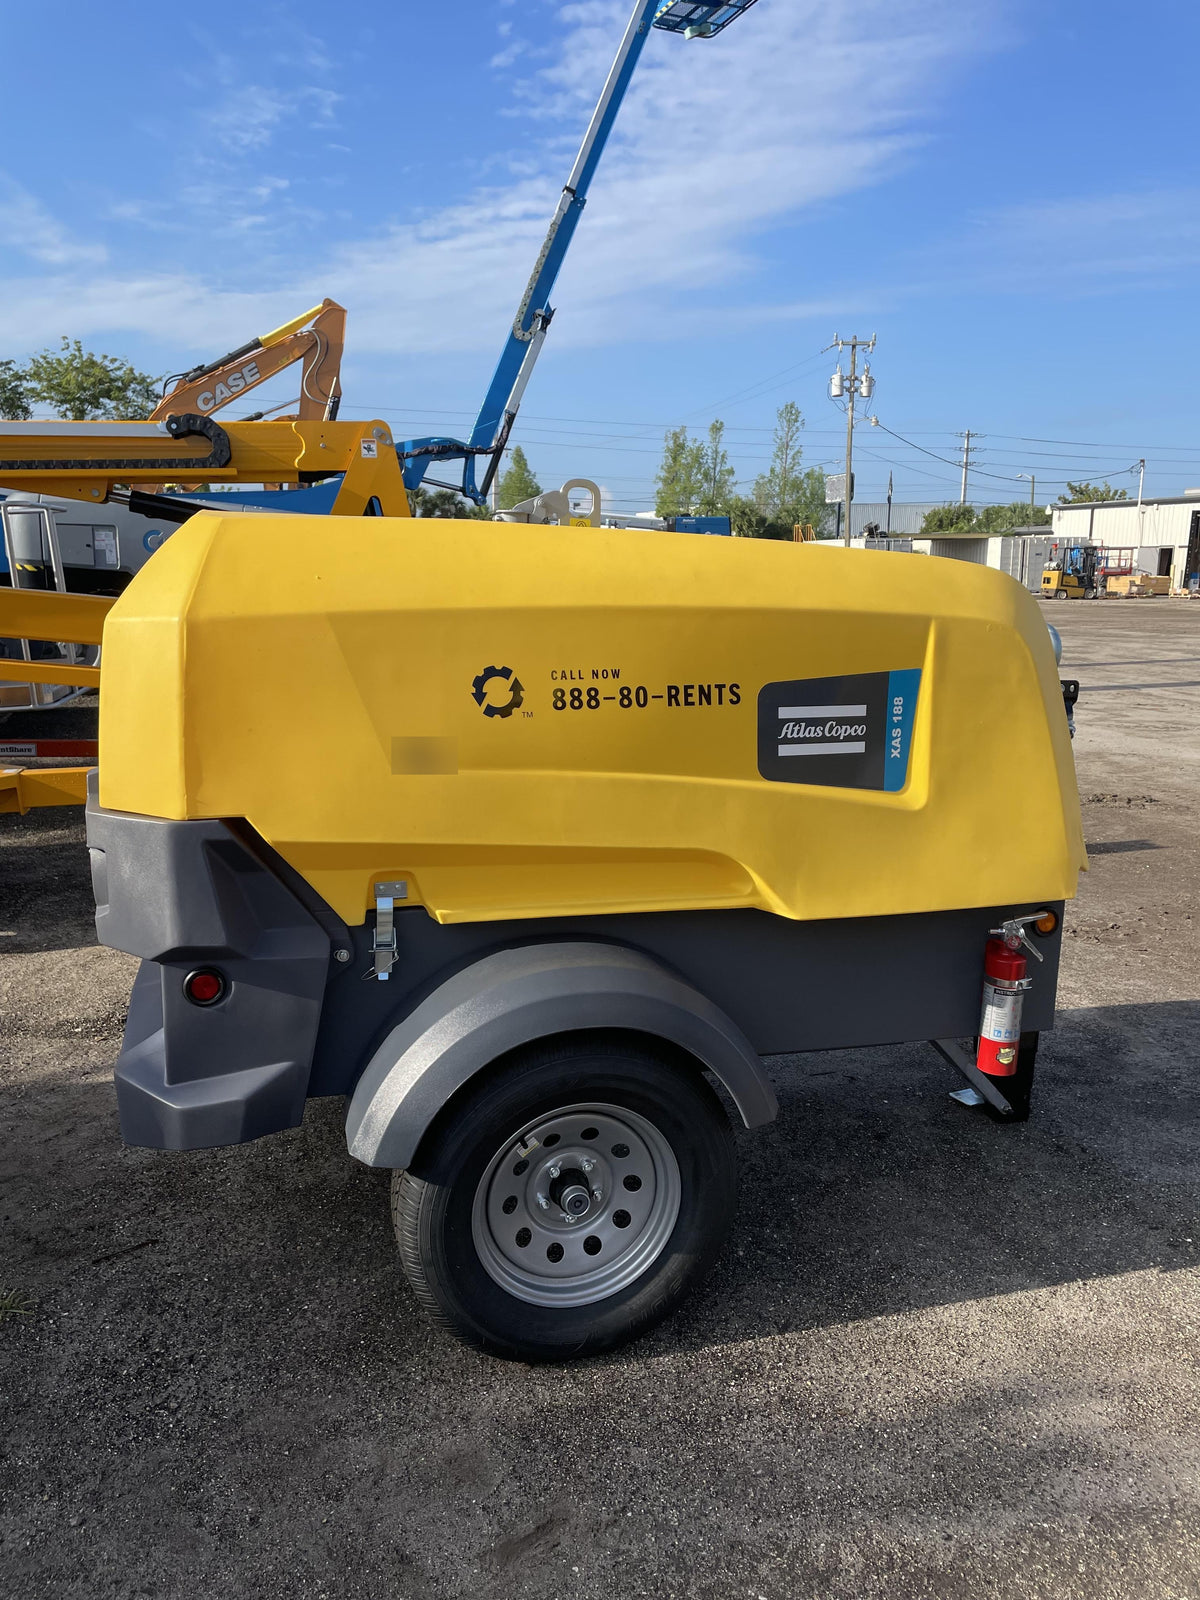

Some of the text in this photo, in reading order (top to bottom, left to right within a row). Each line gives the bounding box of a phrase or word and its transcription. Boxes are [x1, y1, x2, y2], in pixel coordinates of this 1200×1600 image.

[196, 361, 260, 412] CASE
[551, 668, 620, 681] CALL NOW
[552, 683, 741, 711] 888-80-RENTS
[521, 711, 534, 719] TM
[890, 696, 904, 758] XAS 188
[777, 720, 867, 740] Atlas Copco
